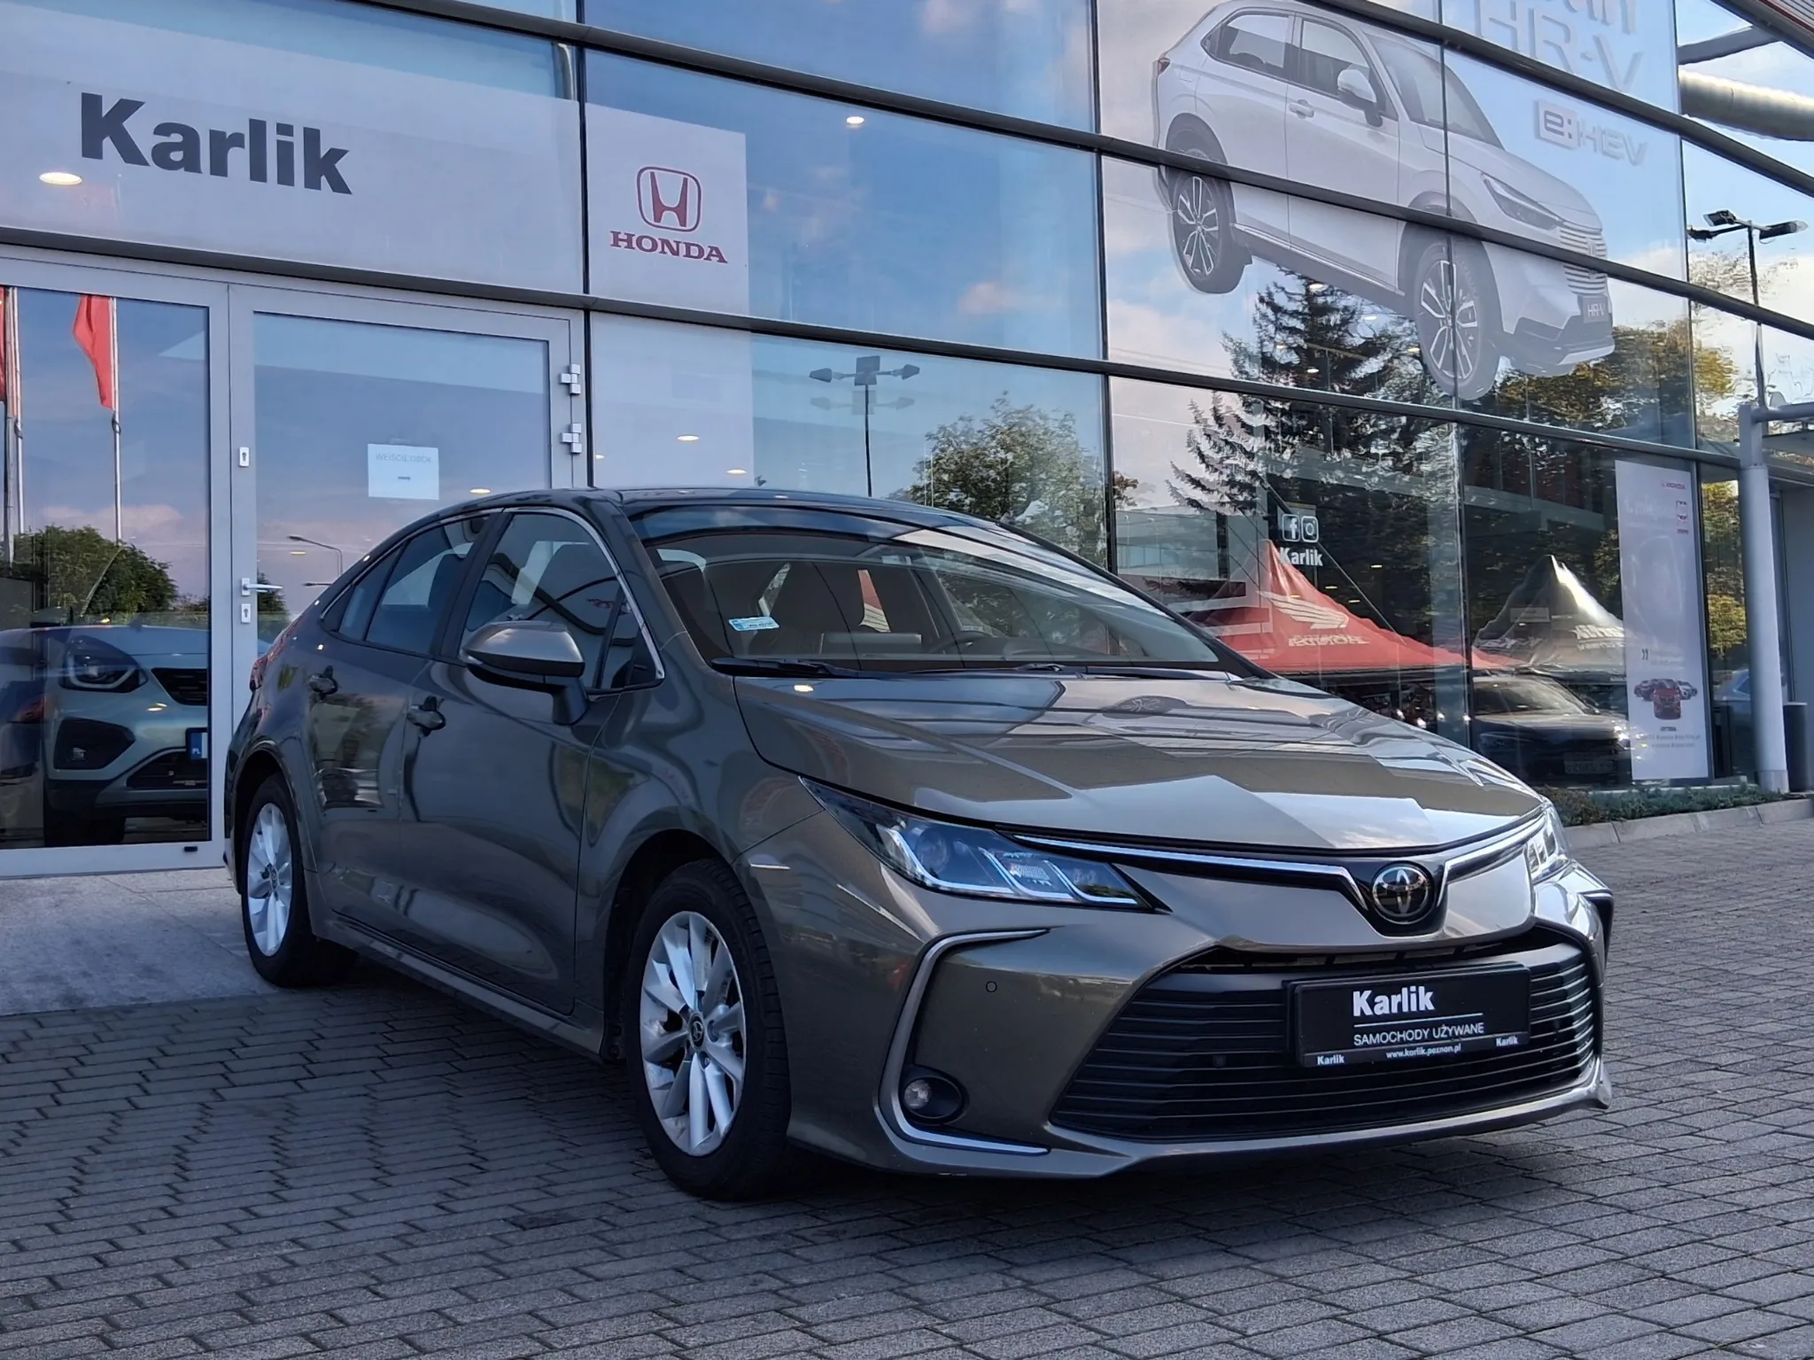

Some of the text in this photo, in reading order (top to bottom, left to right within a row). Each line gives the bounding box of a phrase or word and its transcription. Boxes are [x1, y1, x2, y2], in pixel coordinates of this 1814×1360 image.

[81, 92, 353, 195] Karlik
[610, 231, 728, 264] HONDA
[1280, 547, 1323, 567] Karlik
[1353, 985, 1436, 1017] Karlik
[1353, 1022, 1485, 1046] SAMOCHODY UŻYWANE
[1496, 1035, 1519, 1047] Karlik
[1317, 1054, 1345, 1066] Karlik
